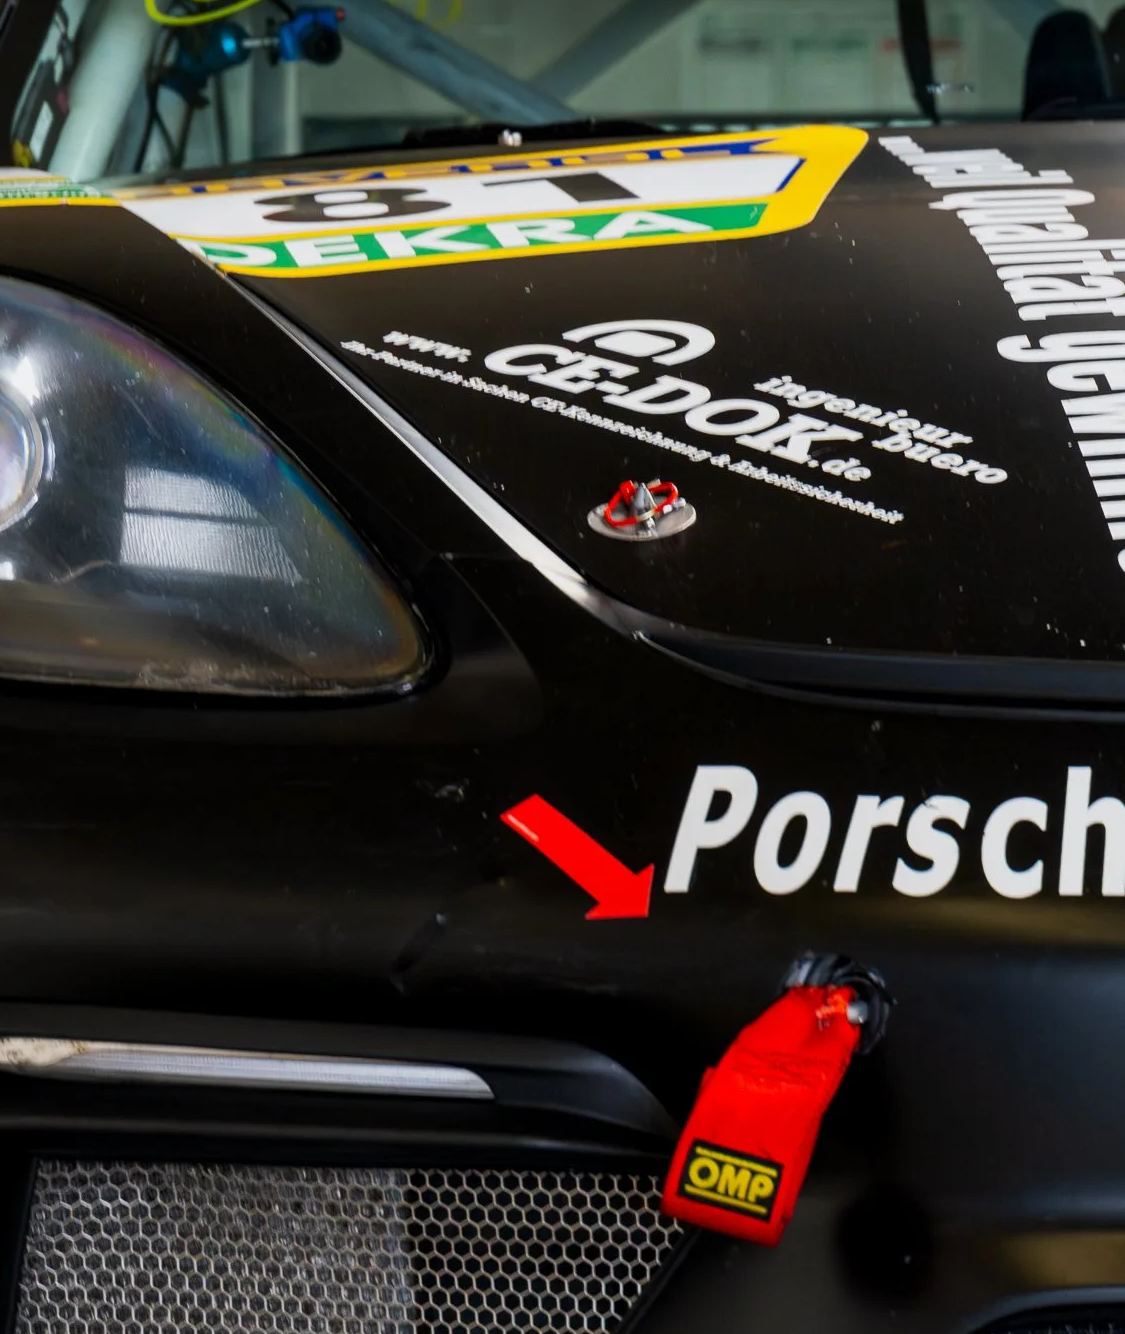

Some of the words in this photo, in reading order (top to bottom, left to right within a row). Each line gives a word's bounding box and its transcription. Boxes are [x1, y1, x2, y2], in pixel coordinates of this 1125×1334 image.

[254, 170, 641, 223] 81
[179, 210, 715, 268] DEKRA
[752, 375, 974, 449] ingenieur
[870, 430, 1009, 485] buero
[663, 764, 1125, 899] Porsch
[688, 1156, 775, 1204] OMP
